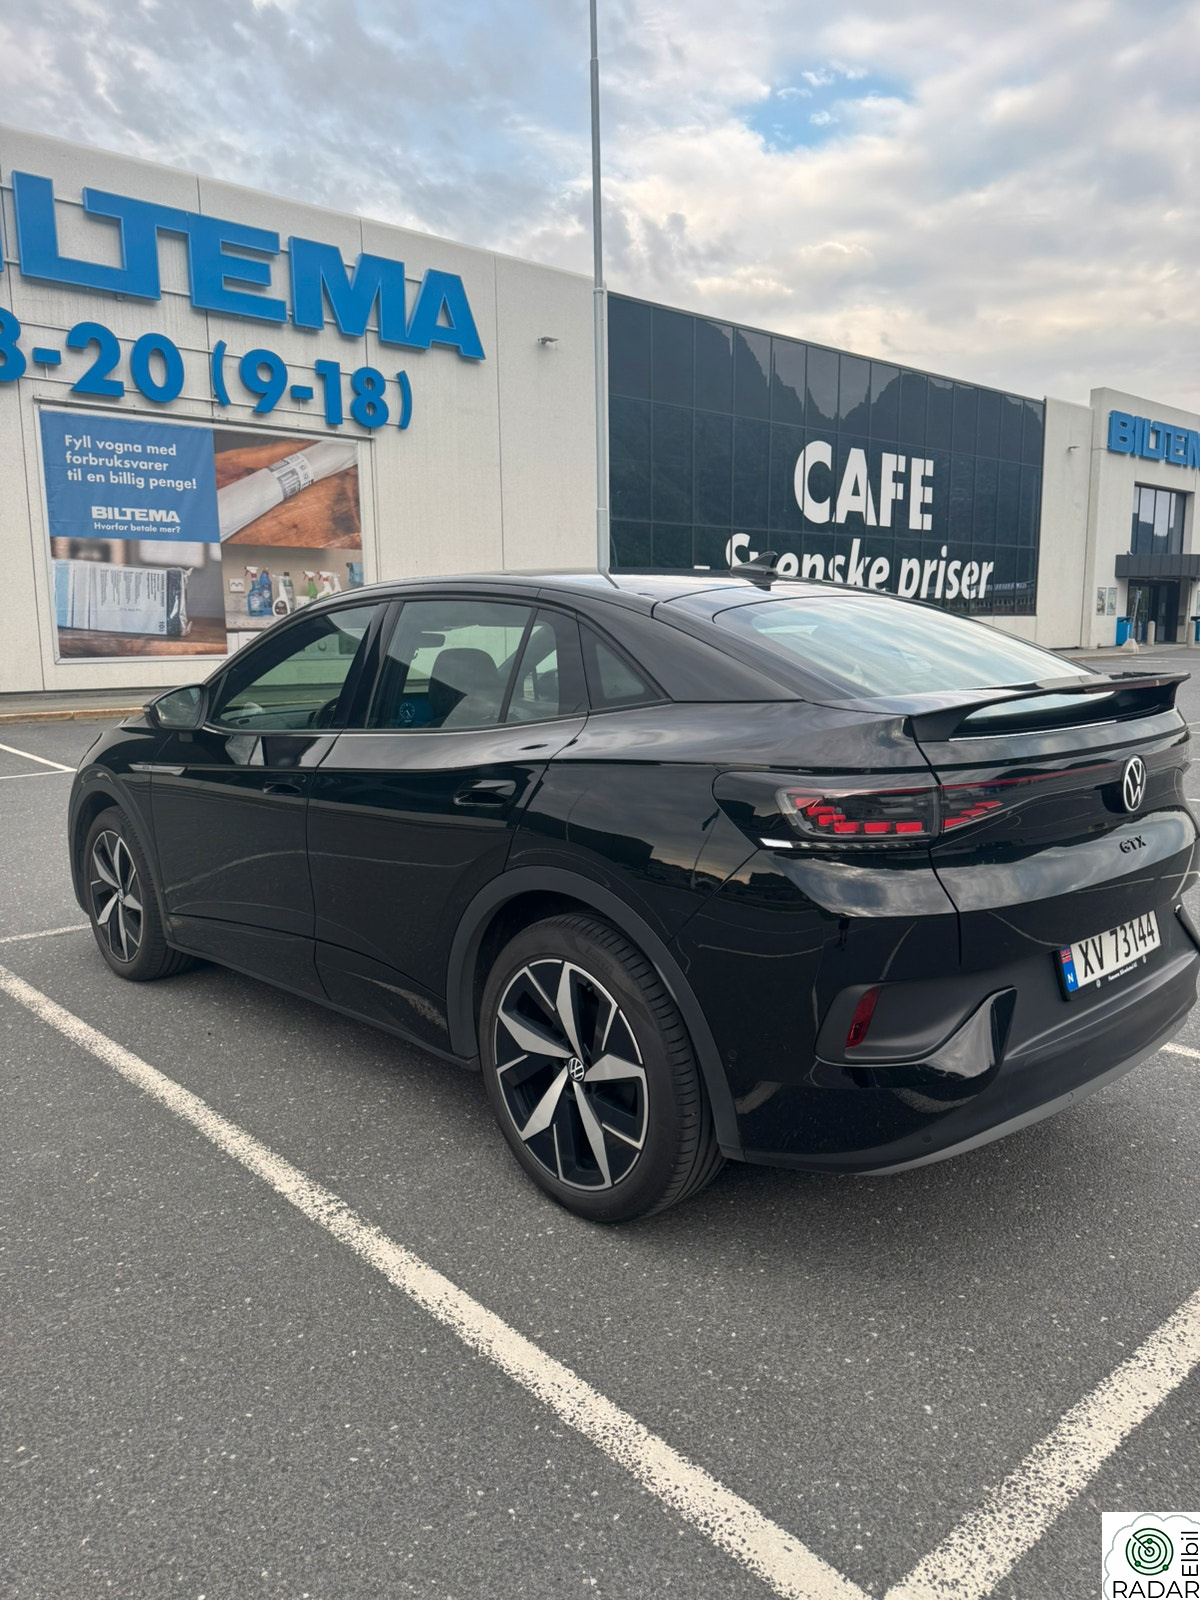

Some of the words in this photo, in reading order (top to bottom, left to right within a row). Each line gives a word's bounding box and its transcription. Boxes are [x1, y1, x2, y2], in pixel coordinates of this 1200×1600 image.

[0, 170, 486, 361] LTEMA
[211, 339, 413, 431] (9-18)
[64, 434, 91, 450] Fyll
[96, 440, 142, 455] vogna
[146, 444, 177, 456] med
[65, 451, 169, 471] forbruksvarer
[66, 468, 82, 481] til
[87, 472, 105, 483] en
[109, 471, 145, 488] billig
[149, 478, 197, 491] penge!
[794, 440, 934, 530] CAFE
[91, 505, 181, 523] BILTEMA
[94, 522, 128, 532] Hvorfor
[130, 523, 157, 533] betale
[725, 533, 890, 592] Senske
[897, 545, 994, 600] priser
[1119, 835, 1147, 853] GTX
[1078, 934, 1104, 978] XV
[1109, 912, 1156, 963] 73144
[1066, 972, 1075, 984] N
